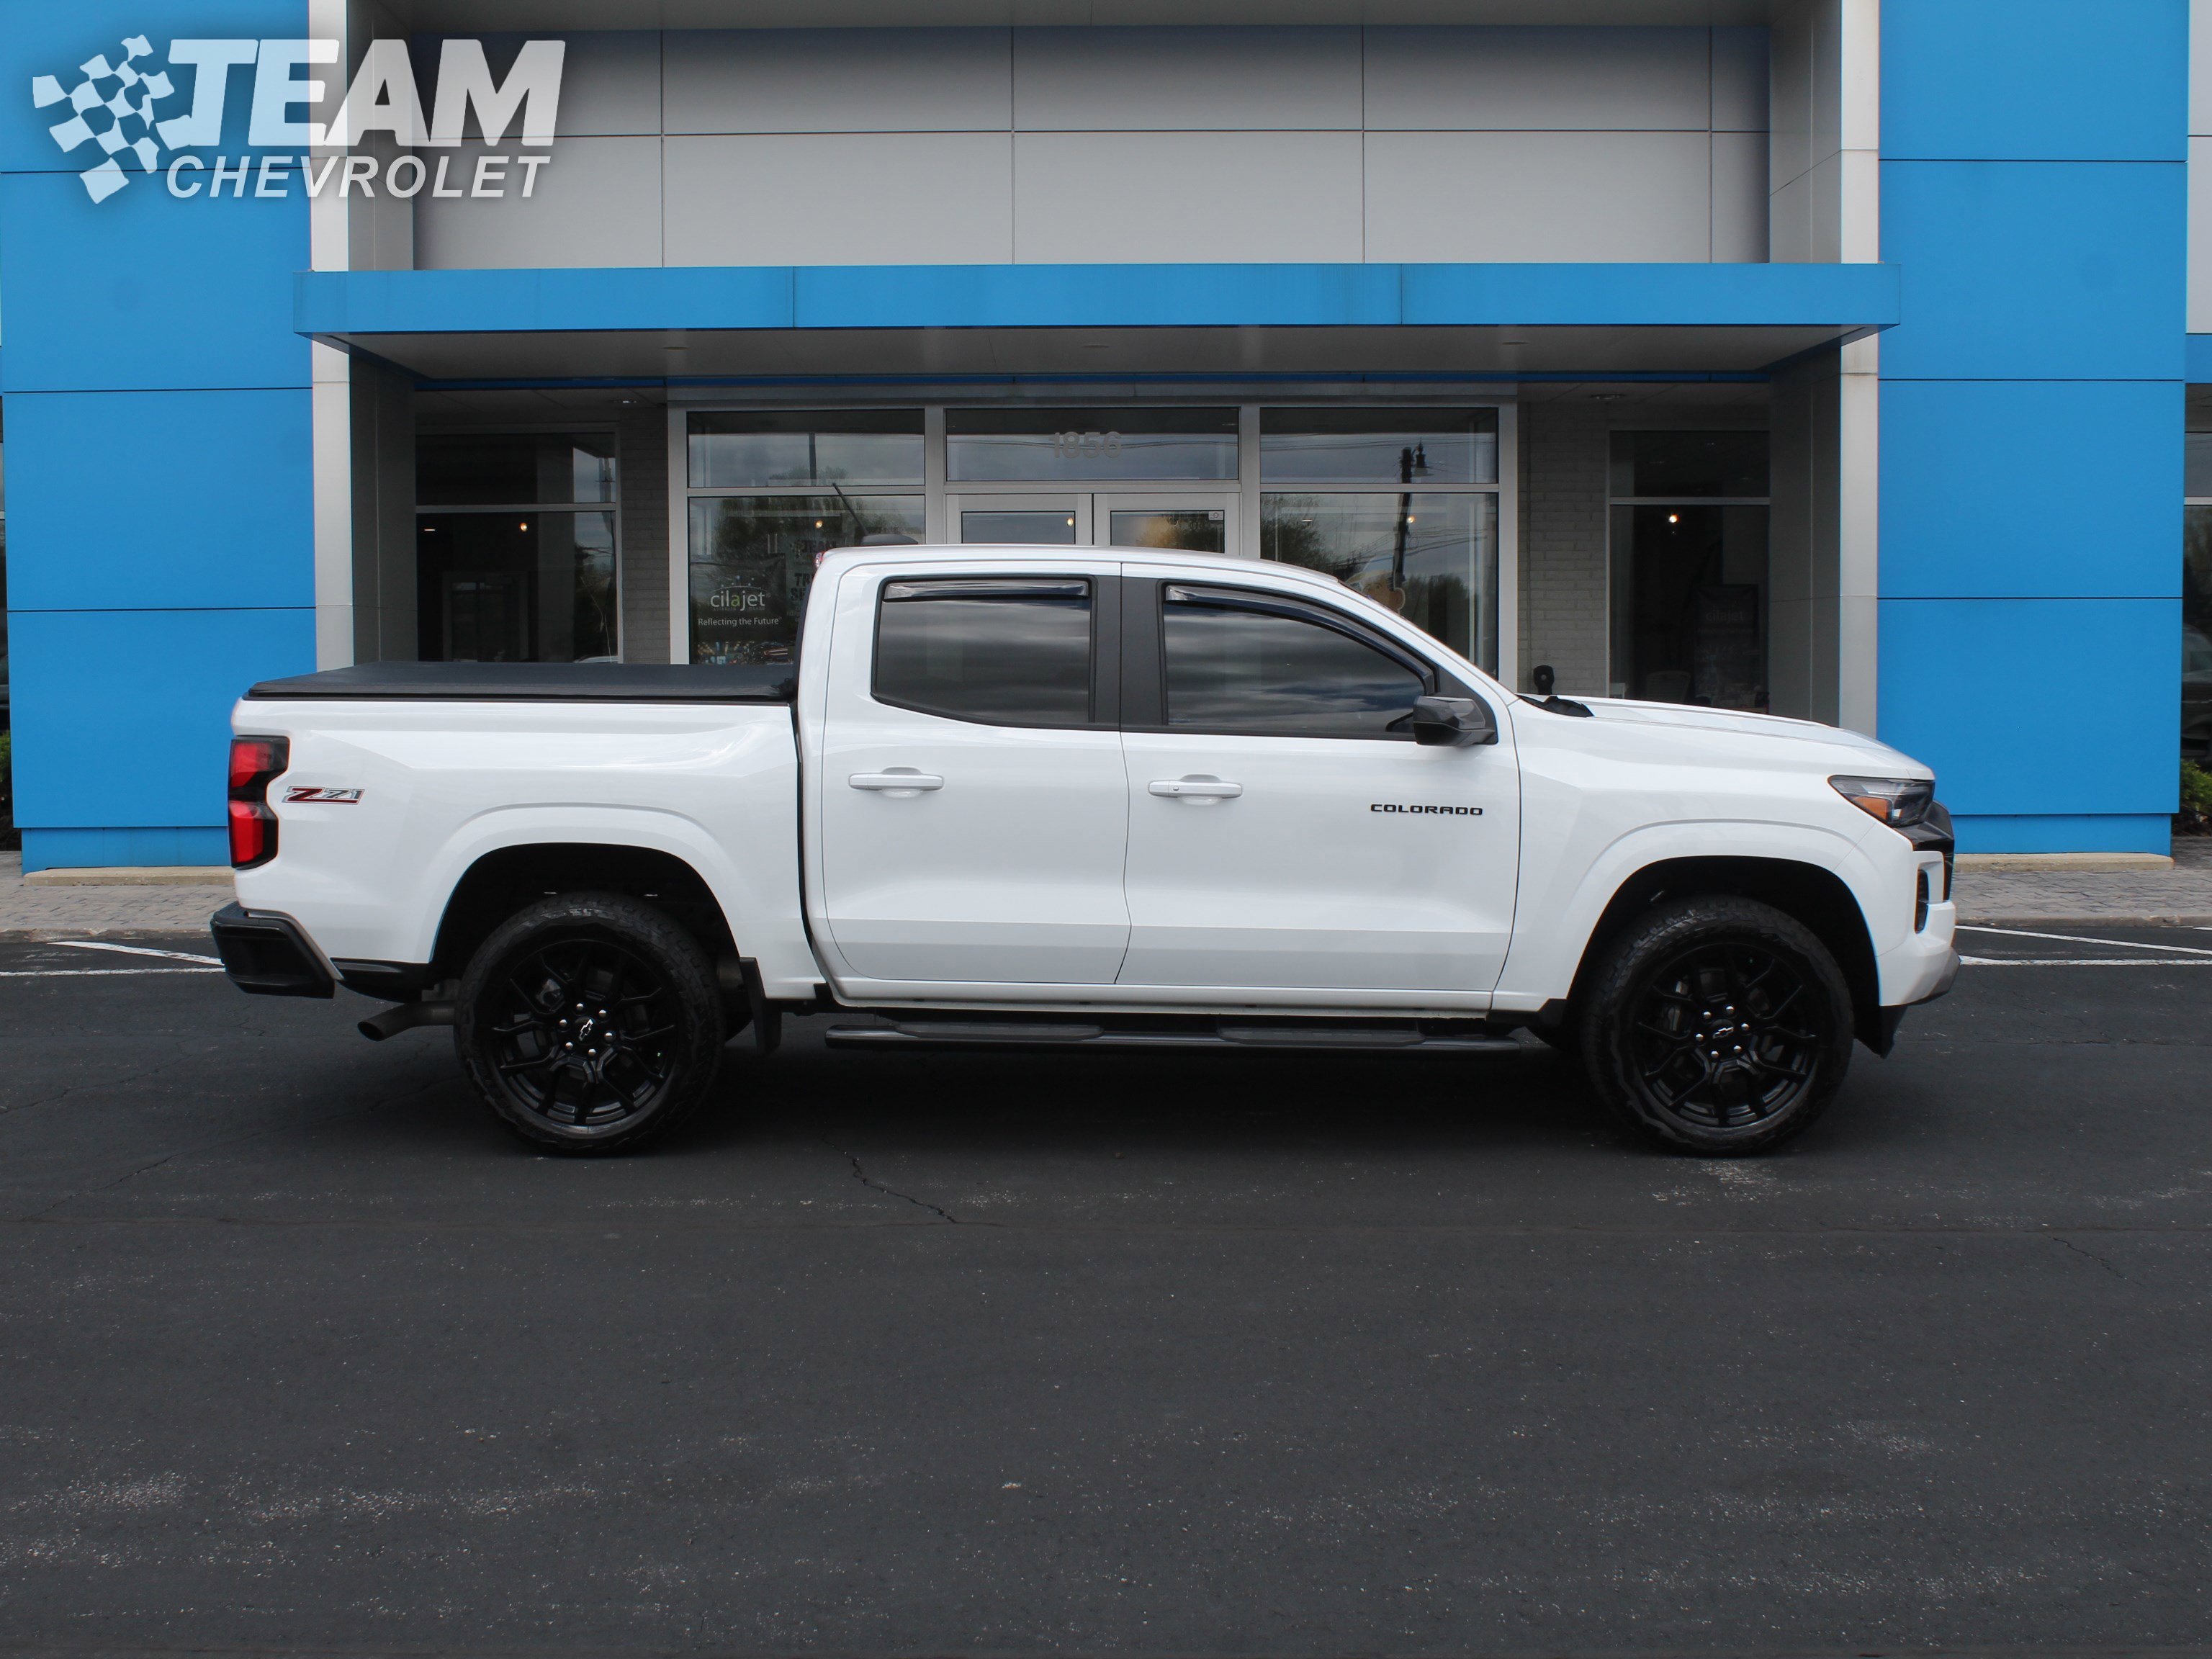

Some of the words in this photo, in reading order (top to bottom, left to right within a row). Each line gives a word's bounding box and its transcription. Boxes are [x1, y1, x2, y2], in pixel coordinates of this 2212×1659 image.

[1048, 431, 1123, 459] 1856
[710, 590, 765, 611] cilajet
[698, 618, 737, 627] Reflecting
[739, 617, 752, 626] the
[282, 786, 365, 805] Z71
[1370, 804, 1483, 816] COLORADO
